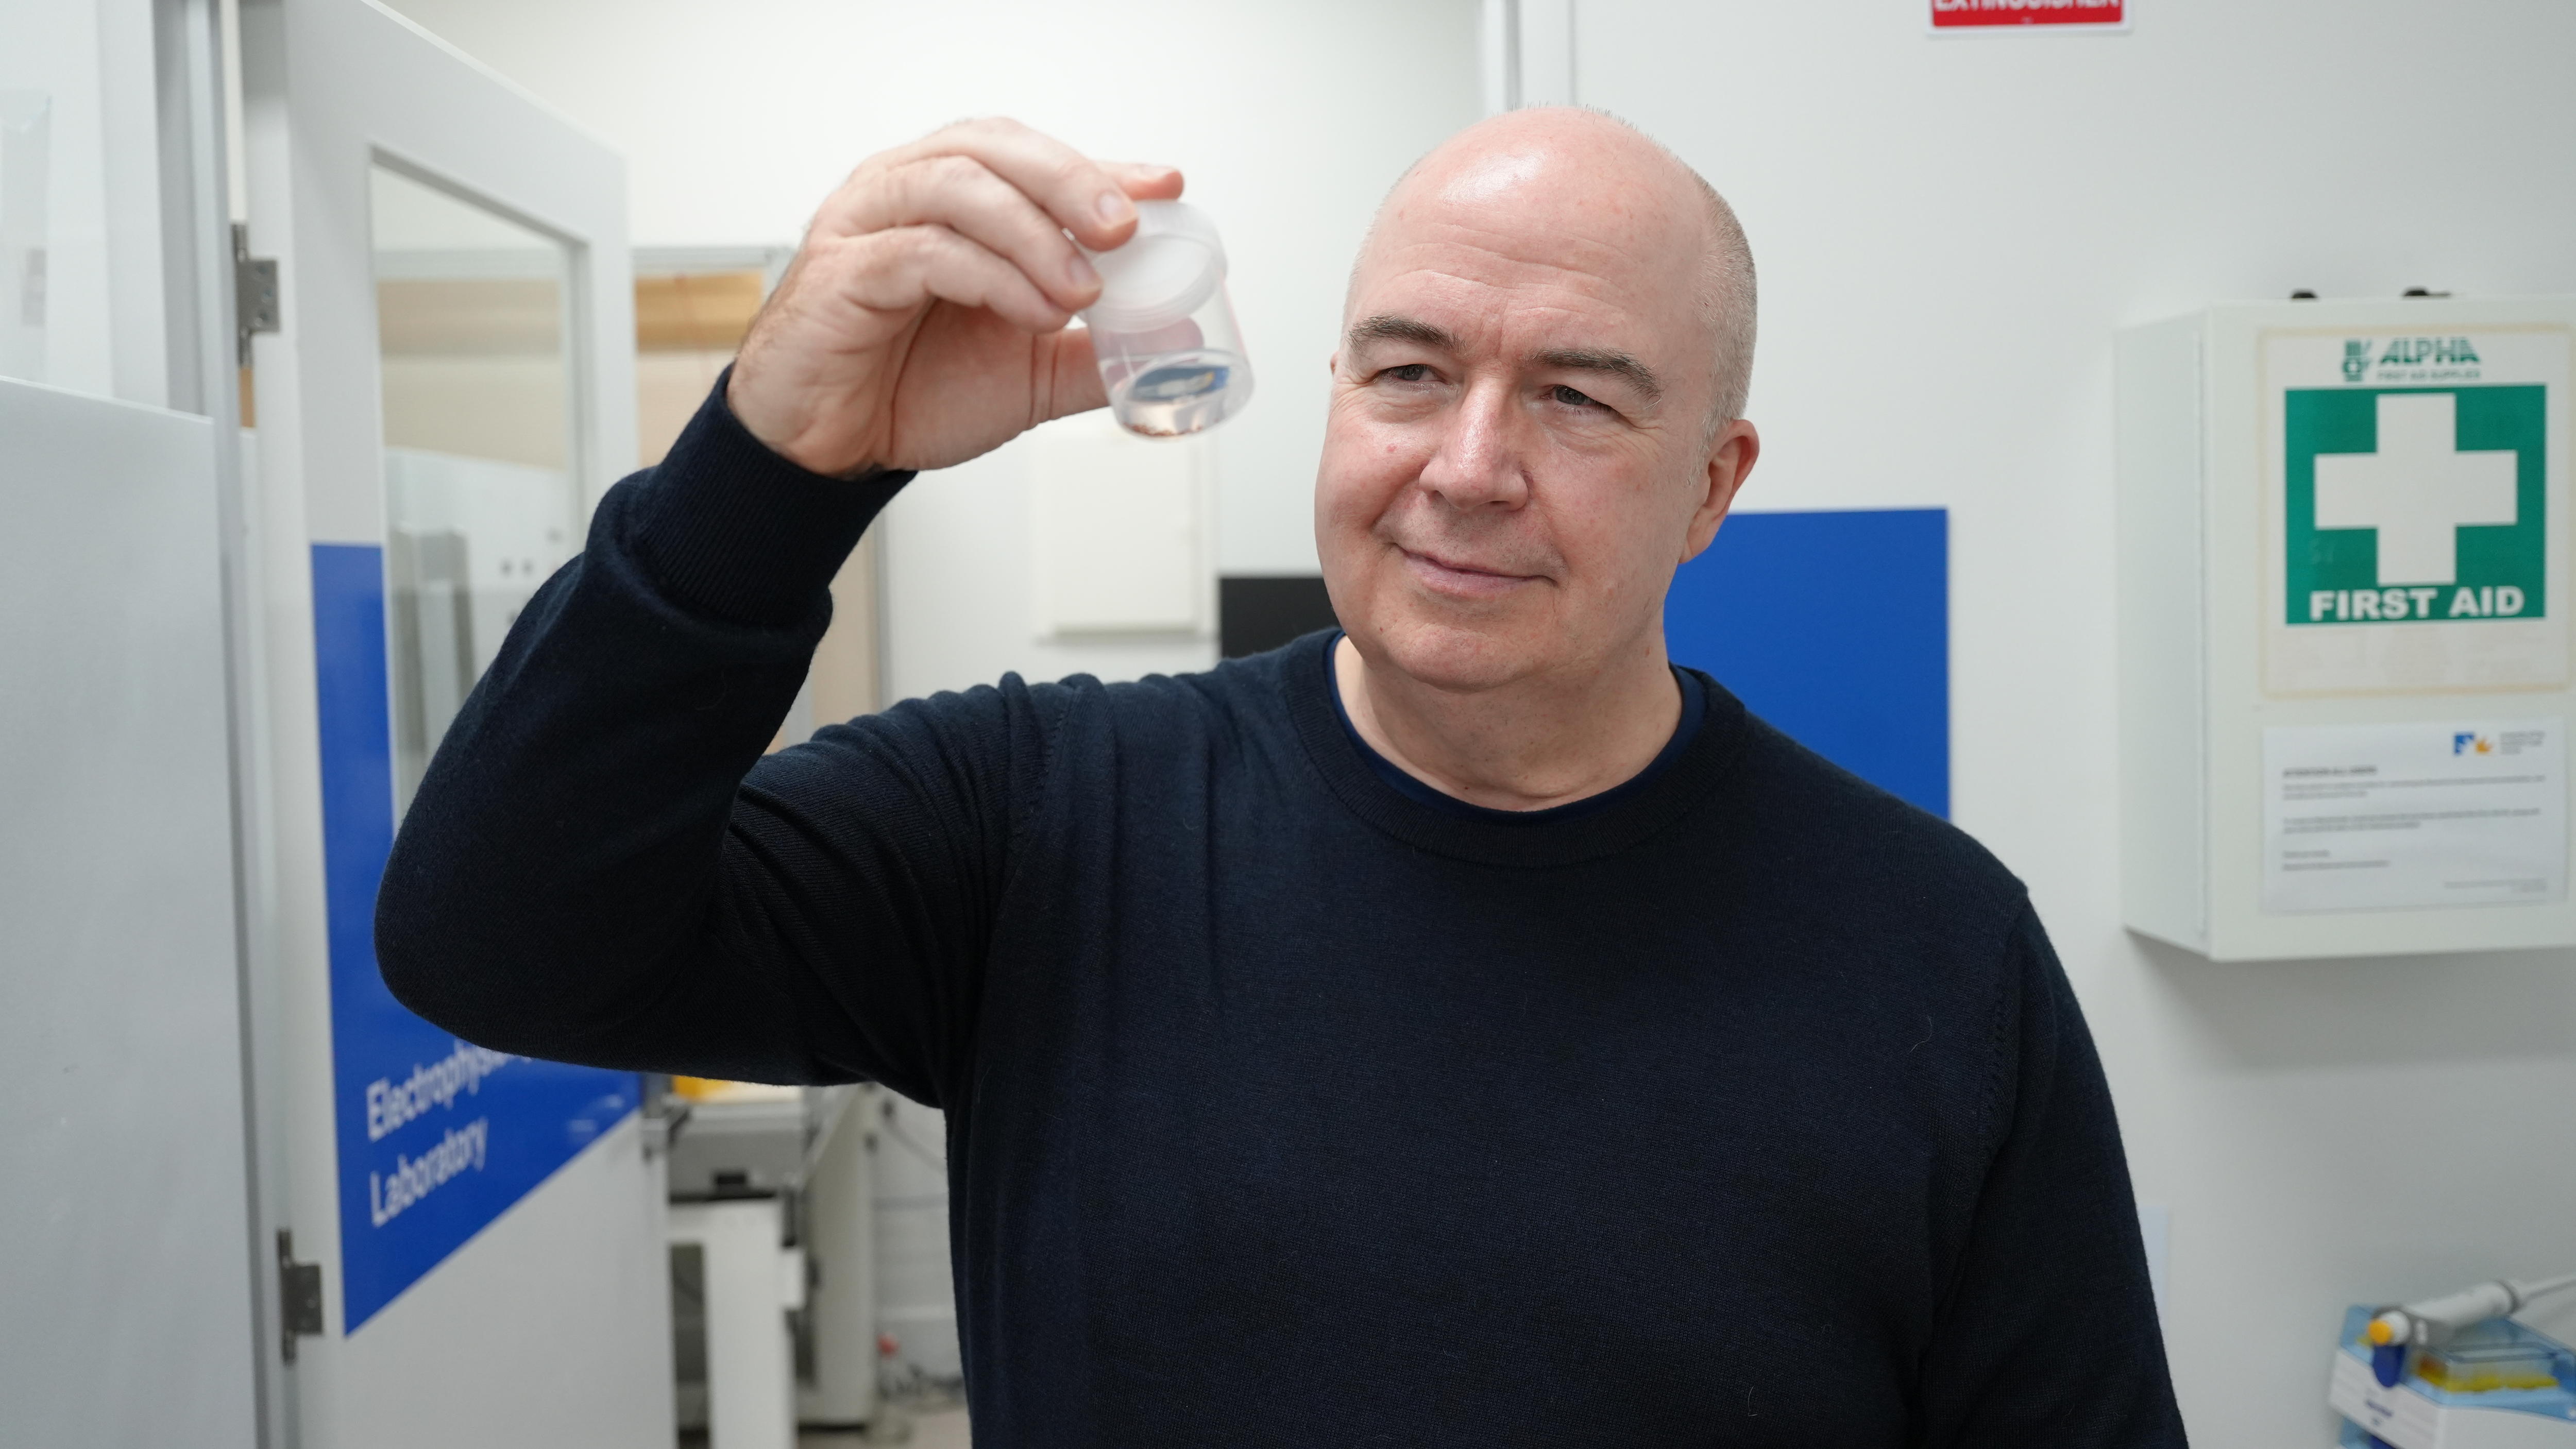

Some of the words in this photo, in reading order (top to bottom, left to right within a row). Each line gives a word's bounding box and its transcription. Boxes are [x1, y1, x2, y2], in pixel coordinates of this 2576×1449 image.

[2379, 337, 2480, 364] ALPHA
[2309, 588, 2437, 621] FIRST
[2448, 585, 2524, 618] AID
[369, 1116, 488, 1227] Laboratory
